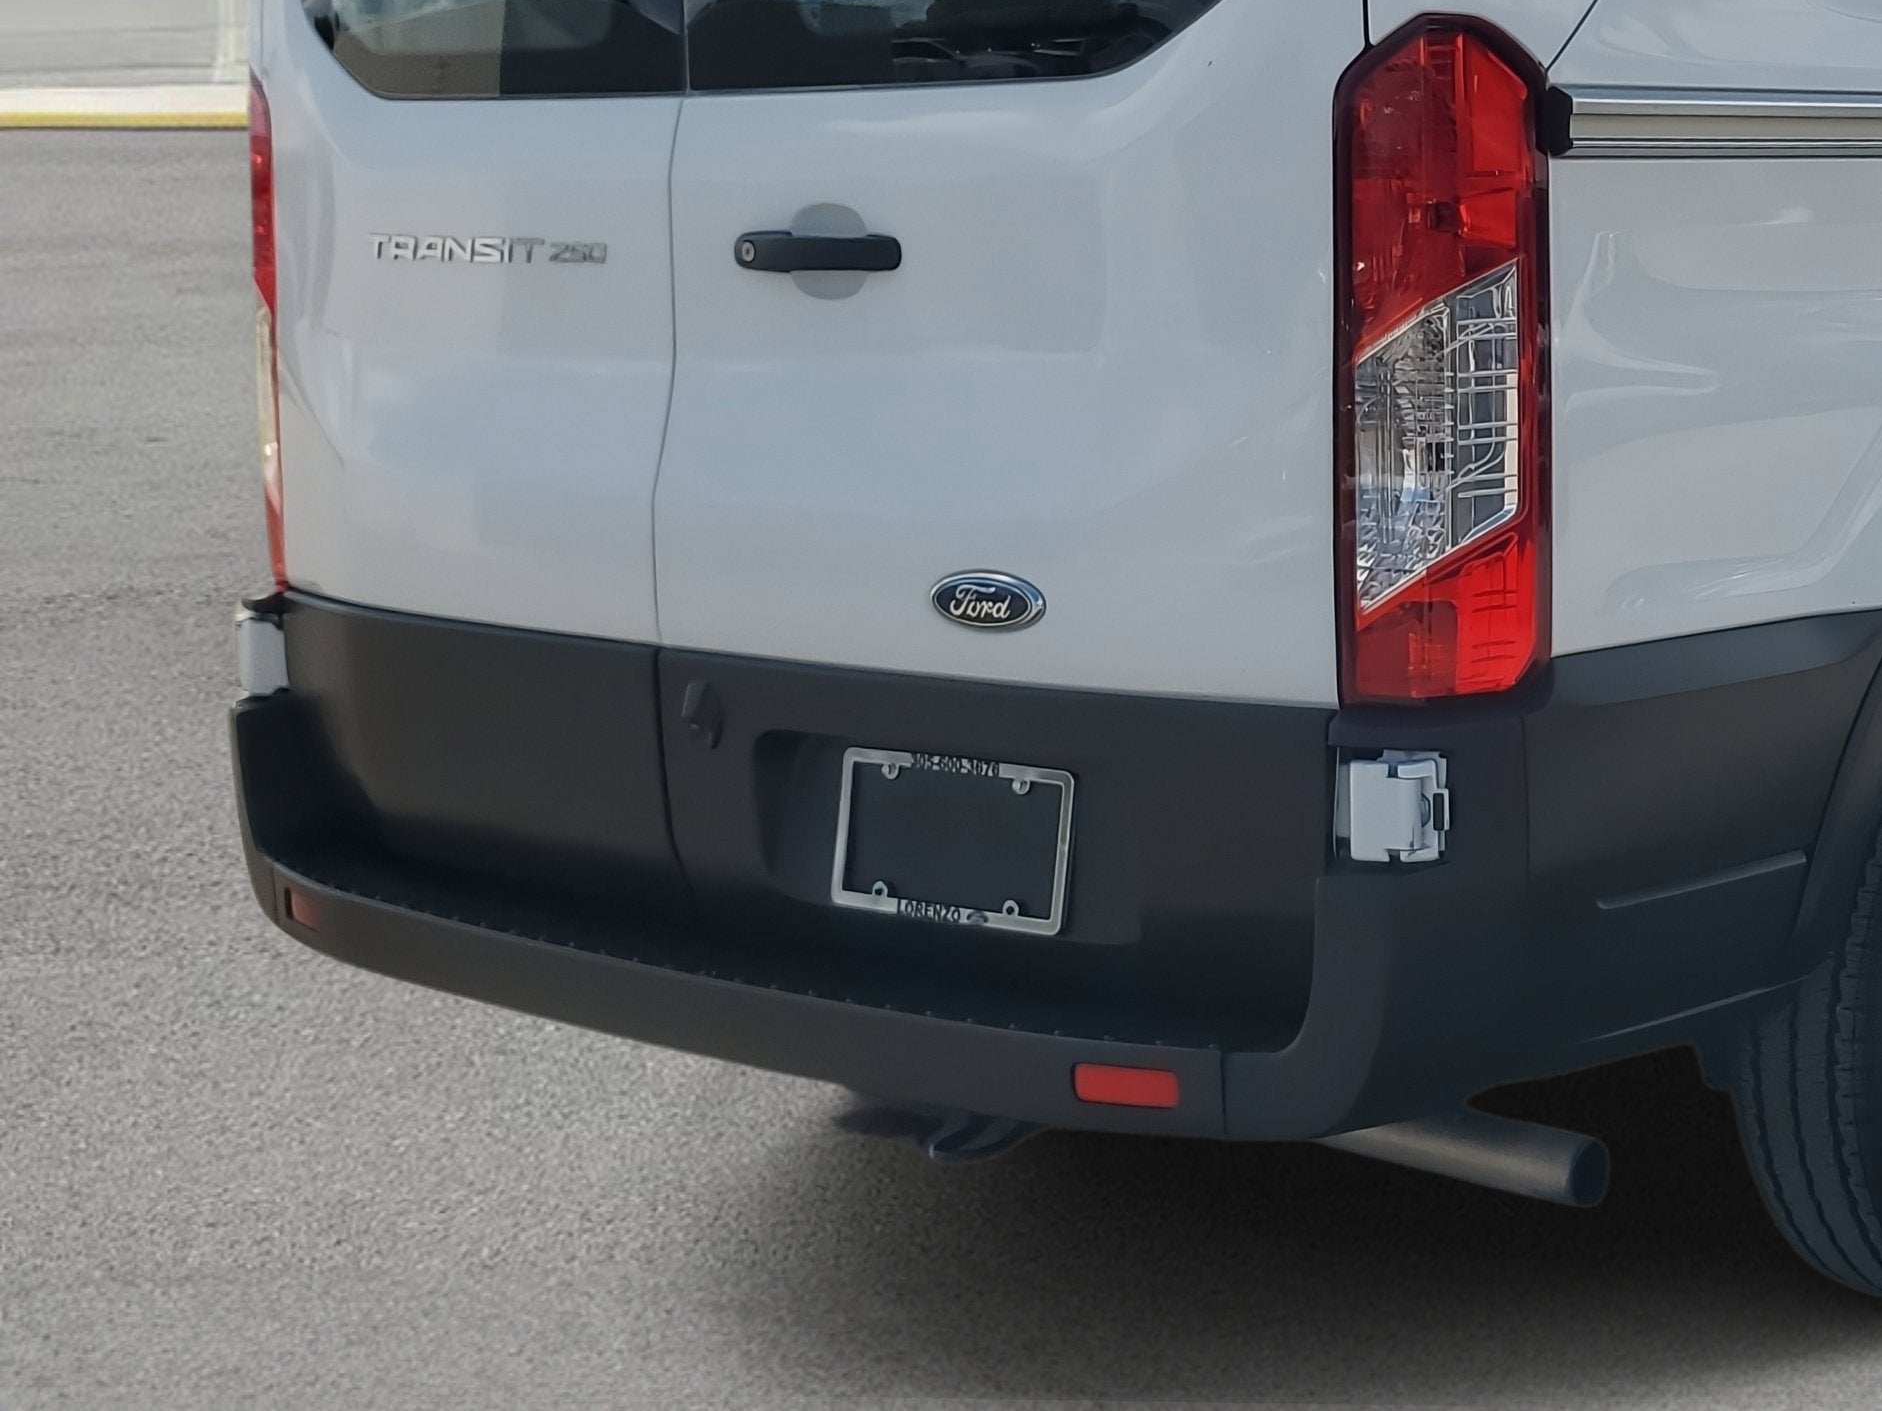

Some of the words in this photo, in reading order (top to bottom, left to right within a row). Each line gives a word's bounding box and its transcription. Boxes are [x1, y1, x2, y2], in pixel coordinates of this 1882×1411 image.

[368, 232, 545, 264] TRANSIT
[548, 241, 607, 264] 250
[950, 584, 1012, 618] Ford
[896, 899, 962, 924] LORENZO
